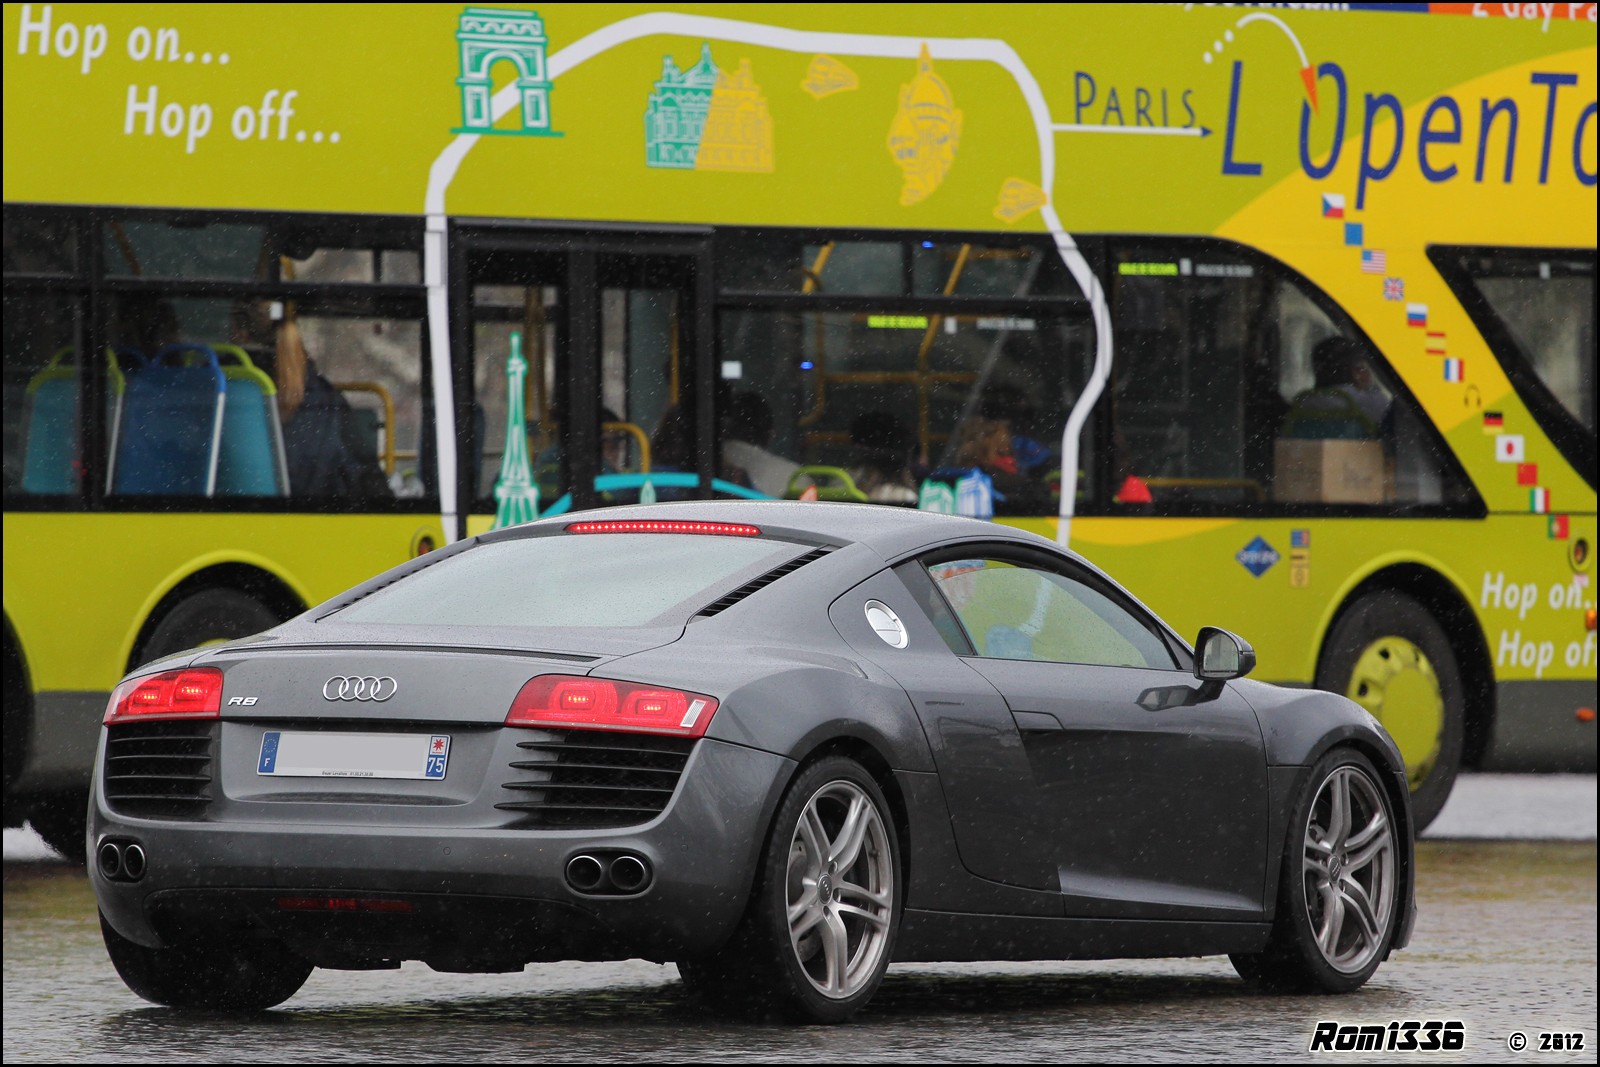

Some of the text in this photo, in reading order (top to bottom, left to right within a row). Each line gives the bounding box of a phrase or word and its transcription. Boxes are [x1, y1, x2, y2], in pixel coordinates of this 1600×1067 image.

[17, 4, 230, 75] Hop on...
[123, 84, 341, 154] Hop off...
[1074, 70, 1196, 130] PARIS
[1481, 571, 1538, 621] Hop
[1497, 629, 1597, 679] Hop of
[228, 696, 259, 706] R8
[264, 757, 271, 767] F
[427, 757, 445, 773] 75
